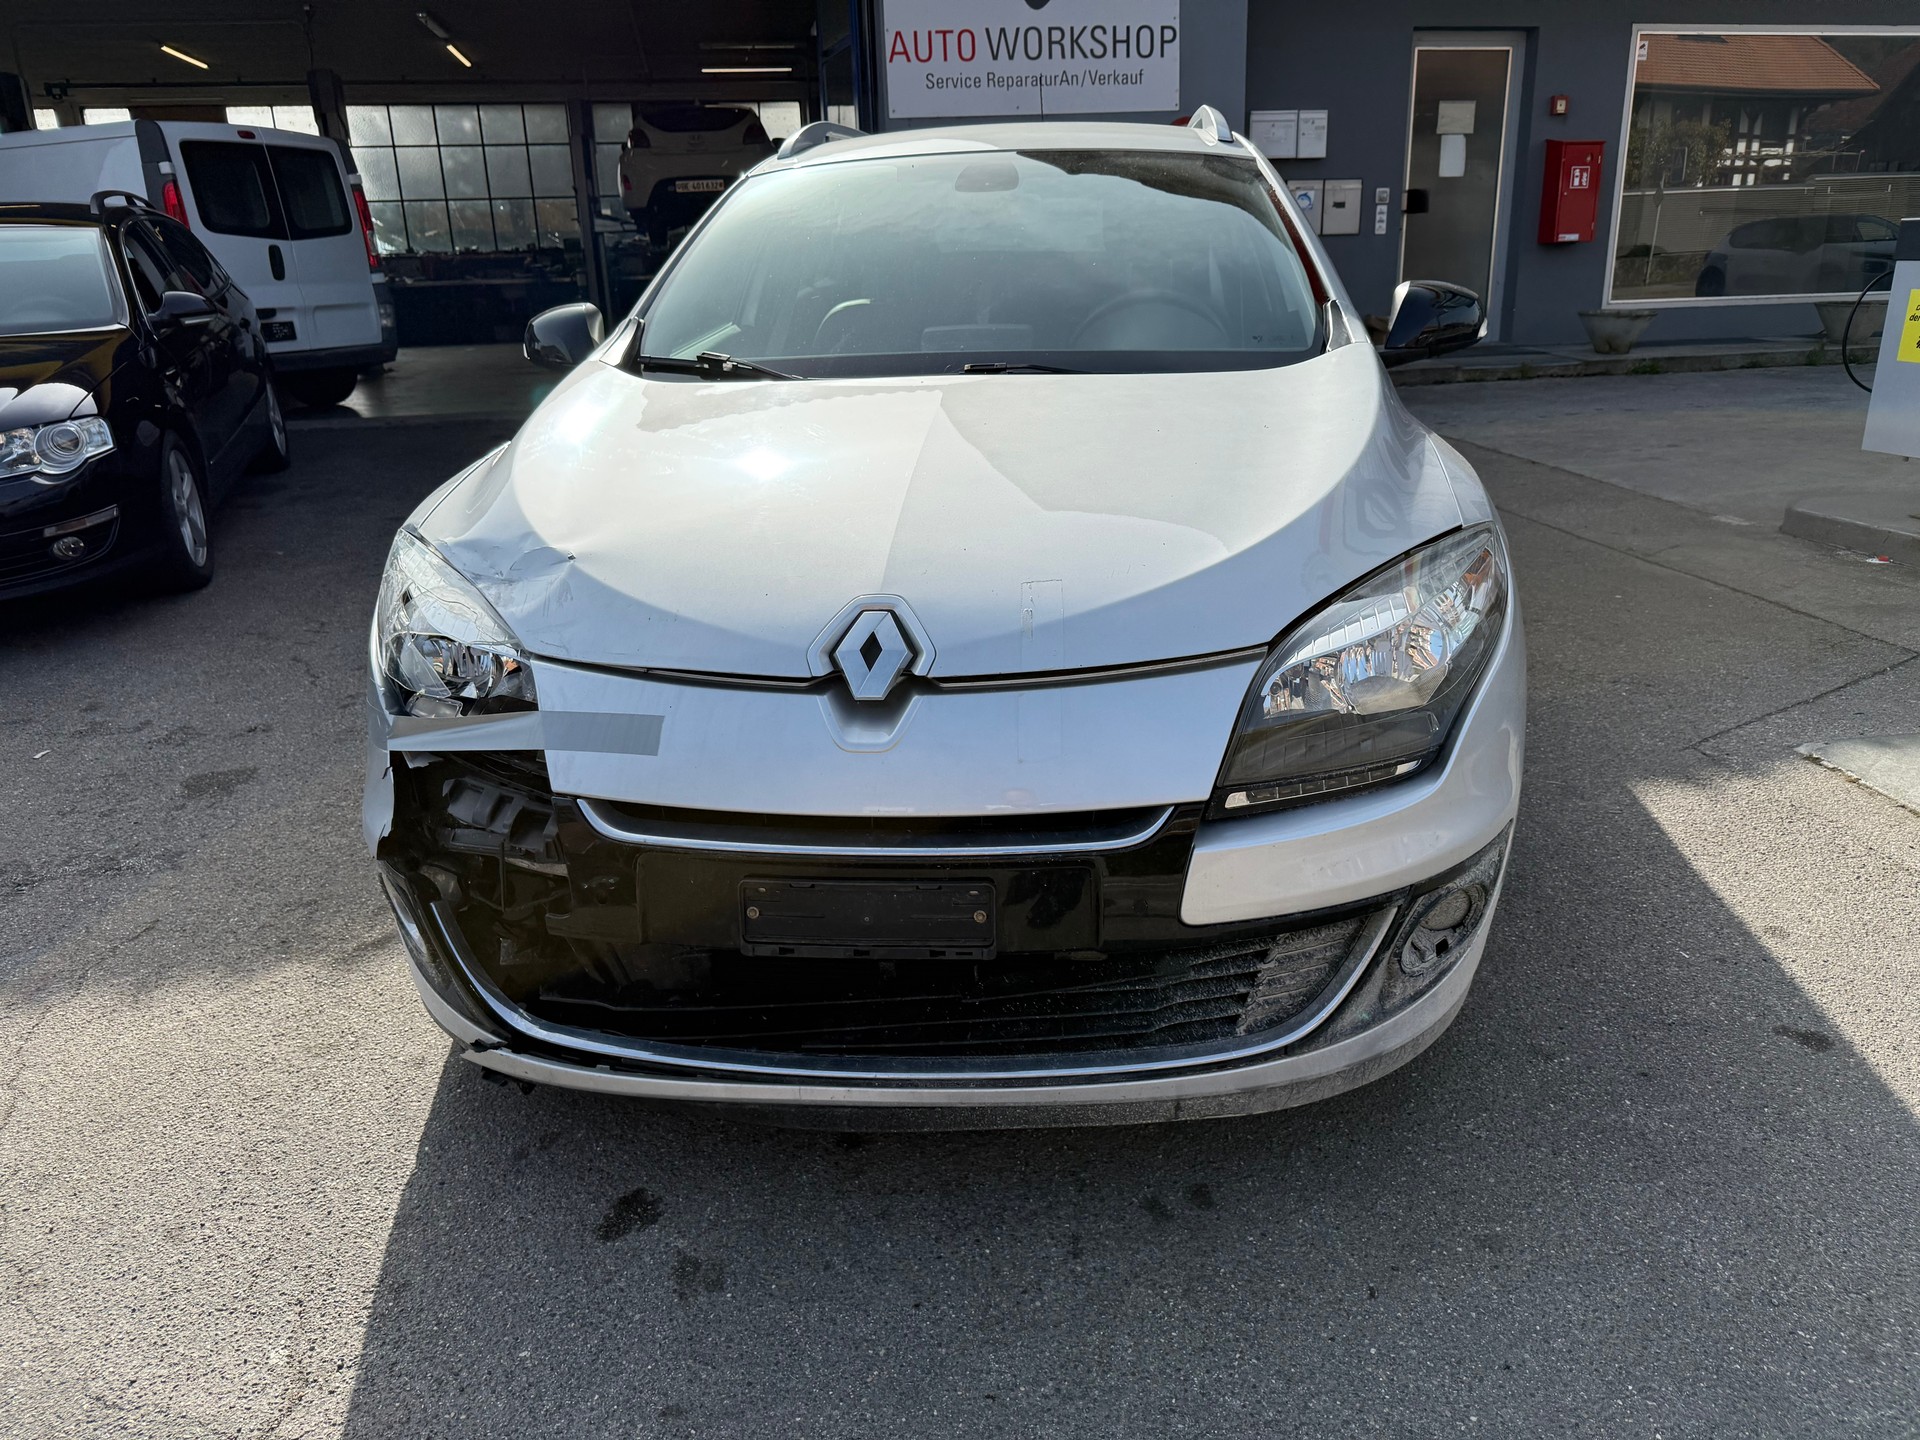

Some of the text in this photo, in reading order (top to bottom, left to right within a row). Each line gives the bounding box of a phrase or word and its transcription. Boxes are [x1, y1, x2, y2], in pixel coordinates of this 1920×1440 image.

[889, 25, 1177, 63] AUTO WORKSHOP
[925, 72, 982, 89] Service
